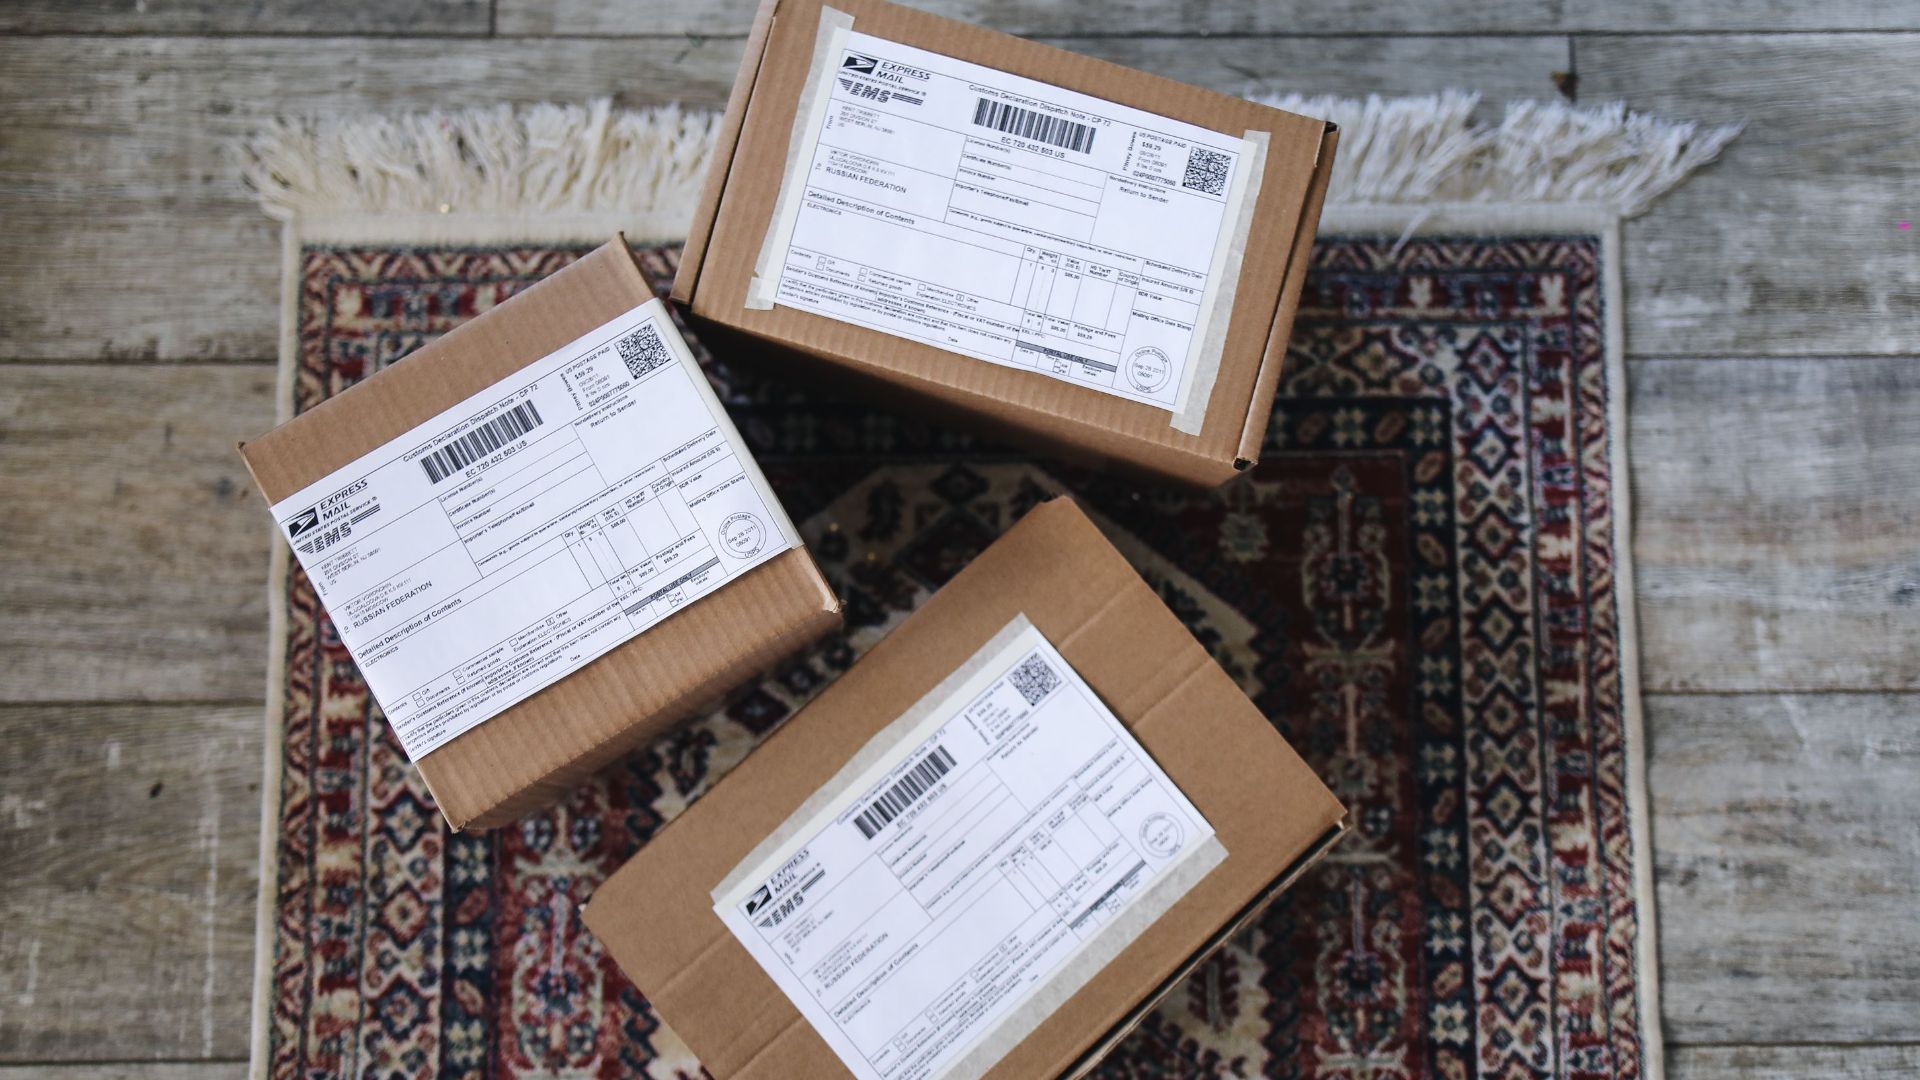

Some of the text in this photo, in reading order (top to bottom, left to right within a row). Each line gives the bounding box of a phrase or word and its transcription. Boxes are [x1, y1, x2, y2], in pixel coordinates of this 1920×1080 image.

[876, 71, 903, 84] MAIL
[881, 62, 931, 80] EXPRESS
[850, 82, 891, 103] EMS
[969, 84, 999, 97] Customs
[1000, 92, 1038, 107] Declaration
[1040, 102, 1069, 115] Dispatch
[1070, 111, 1086, 120] Note
[1103, 119, 1111, 127] 72
[1001, 136, 1011, 145] EC
[1013, 139, 1026, 148] 720
[1026, 144, 1040, 152] 432
[1054, 151, 1065, 159] US
[826, 166, 907, 193] RUSSIAN FEDERATION
[1120, 187, 1139, 195] Return
[1148, 194, 1168, 203] Sender
[808, 190, 835, 203] Detailed
[836, 198, 875, 213] Description
[884, 211, 915, 225] Contents
[403, 443, 433, 462] Customs
[432, 423, 470, 446] Declaration
[470, 407, 499, 425] Dispatch
[498, 398, 514, 409] Note
[519, 388, 529, 398] CP
[529, 383, 538, 392] 72
[590, 415, 609, 428] Return
[617, 399, 636, 413] Sender
[465, 440, 527, 478] EC 720 432 503 US
[320, 479, 368, 510] EXPRESS
[651, 476, 671, 490] Country
[689, 475, 746, 508] Mailing Office Date Stamp
[322, 502, 350, 521] MAIL
[313, 522, 352, 553] EMS
[353, 607, 386, 628] RUSSIAN
[385, 581, 432, 610] FEDERATION
[358, 598, 462, 659] Detailed Description of Contents
[770, 850, 809, 885] EXPRESS
[774, 873, 796, 894] MAIL
[772, 892, 804, 925] EMS
[824, 966, 851, 989] RUSSIAN
[850, 933, 888, 966] FEDERATION
[834, 943, 919, 1017] Detailed Description of Contents
